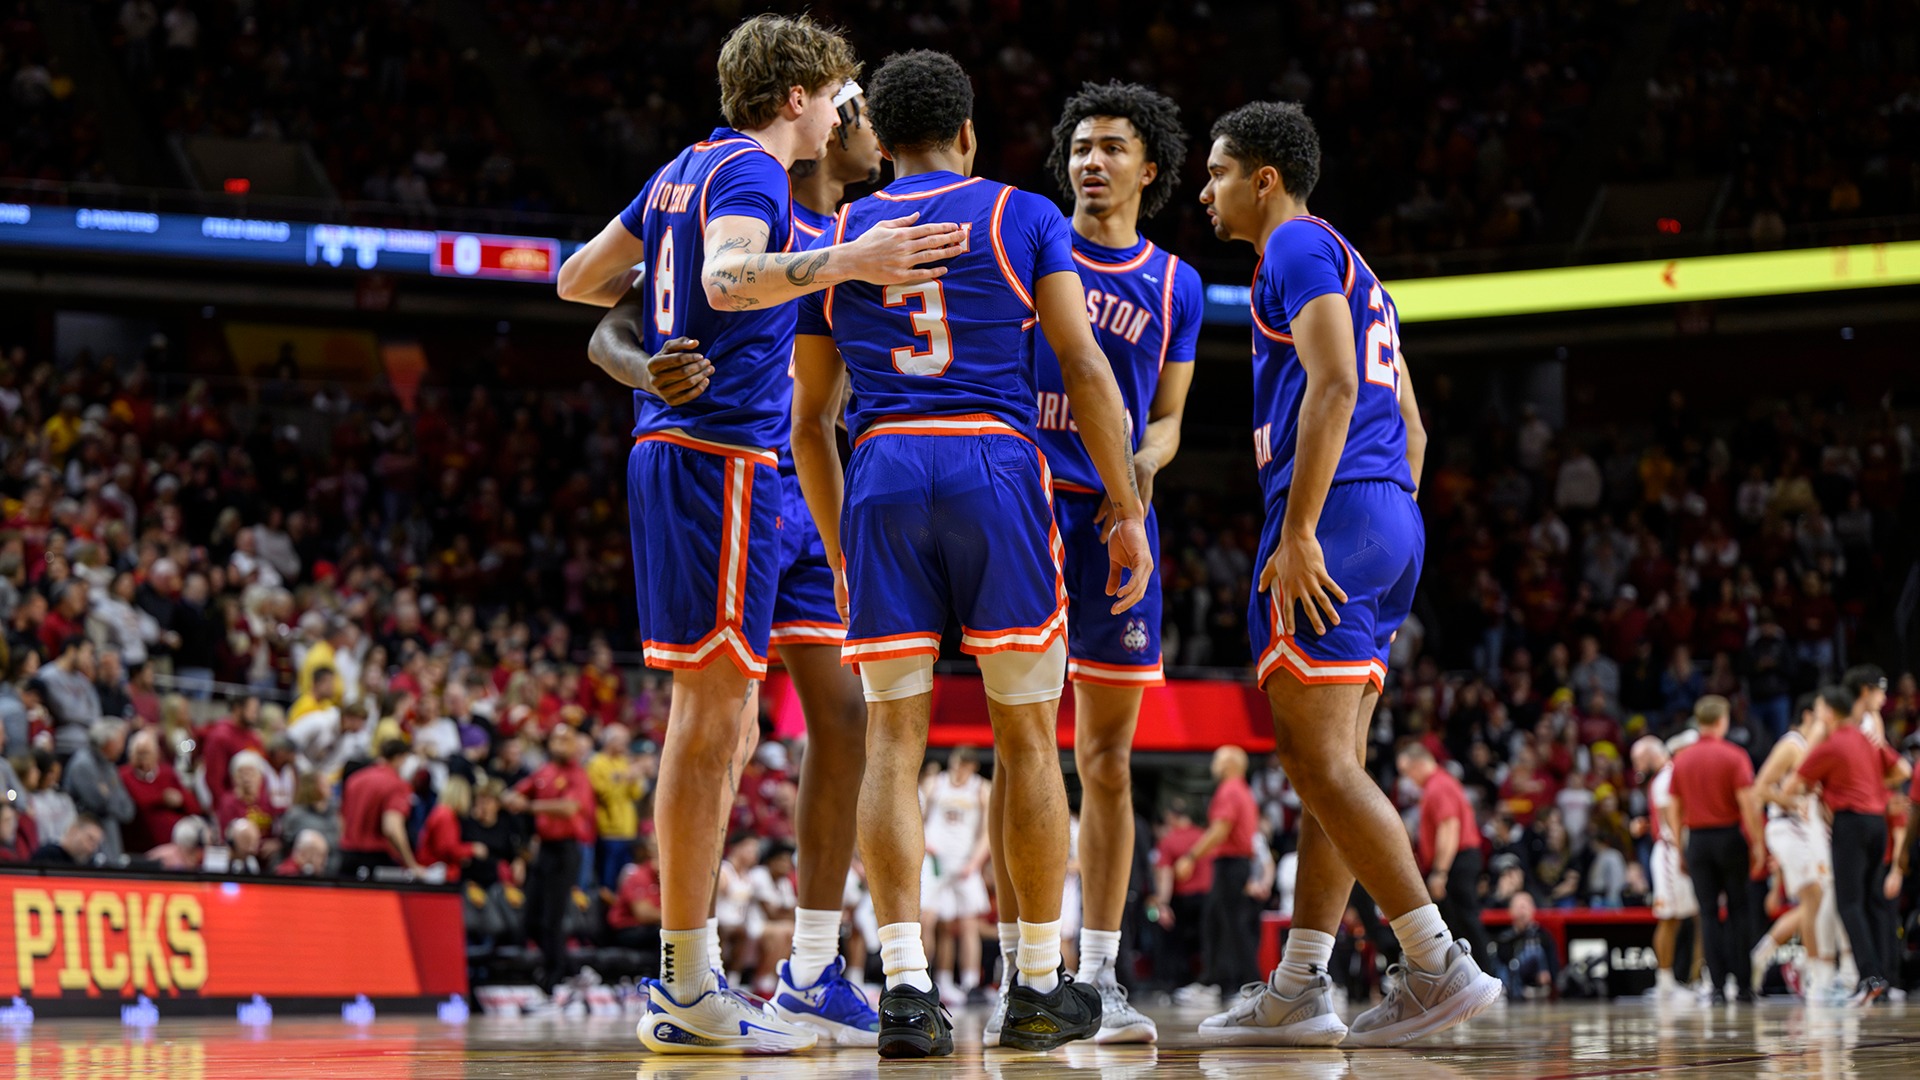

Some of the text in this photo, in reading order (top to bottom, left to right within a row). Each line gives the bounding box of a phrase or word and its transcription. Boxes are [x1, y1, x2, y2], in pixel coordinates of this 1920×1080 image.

[654, 226, 675, 335] 8
[882, 278, 954, 377] 3
[1086, 288, 1152, 345] STON
[13, 888, 208, 990] PICKS
